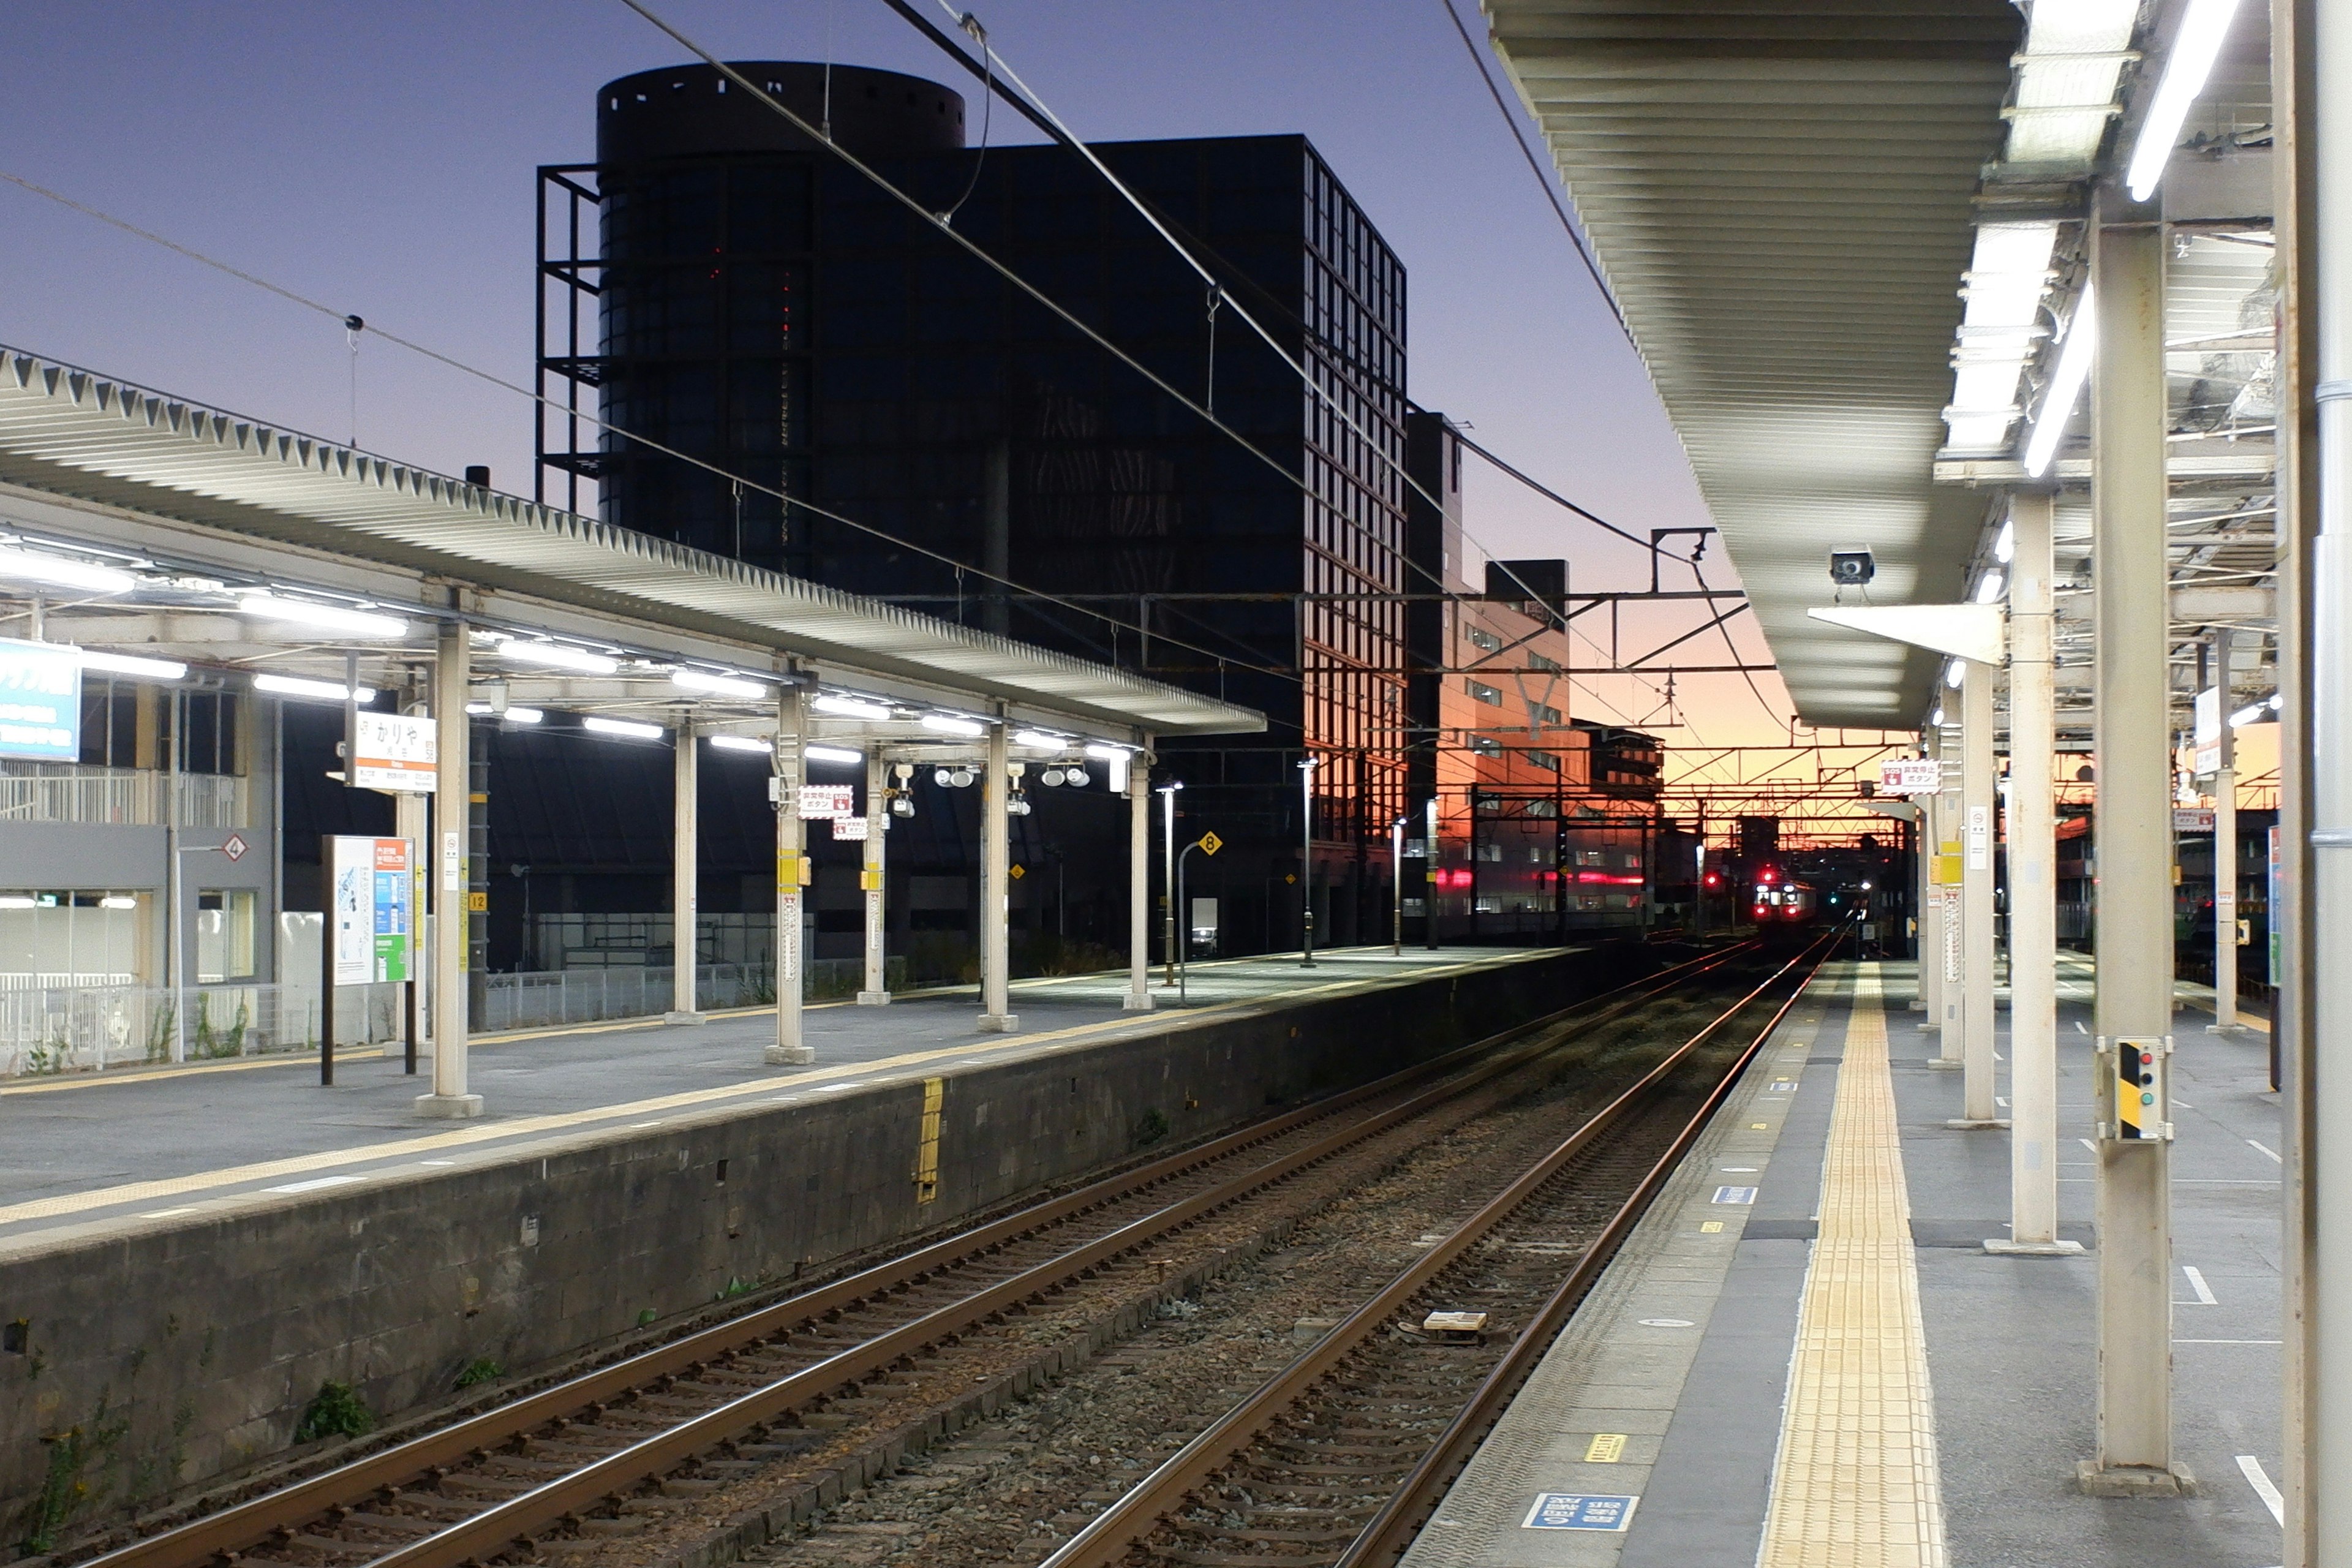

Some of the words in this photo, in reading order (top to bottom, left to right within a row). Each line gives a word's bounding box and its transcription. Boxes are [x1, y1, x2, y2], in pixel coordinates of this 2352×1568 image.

[377, 722, 417, 745] かりや
[229, 839, 239, 855] 4
[1205, 835, 1215, 851] 8
[473, 896, 485, 907] 12
